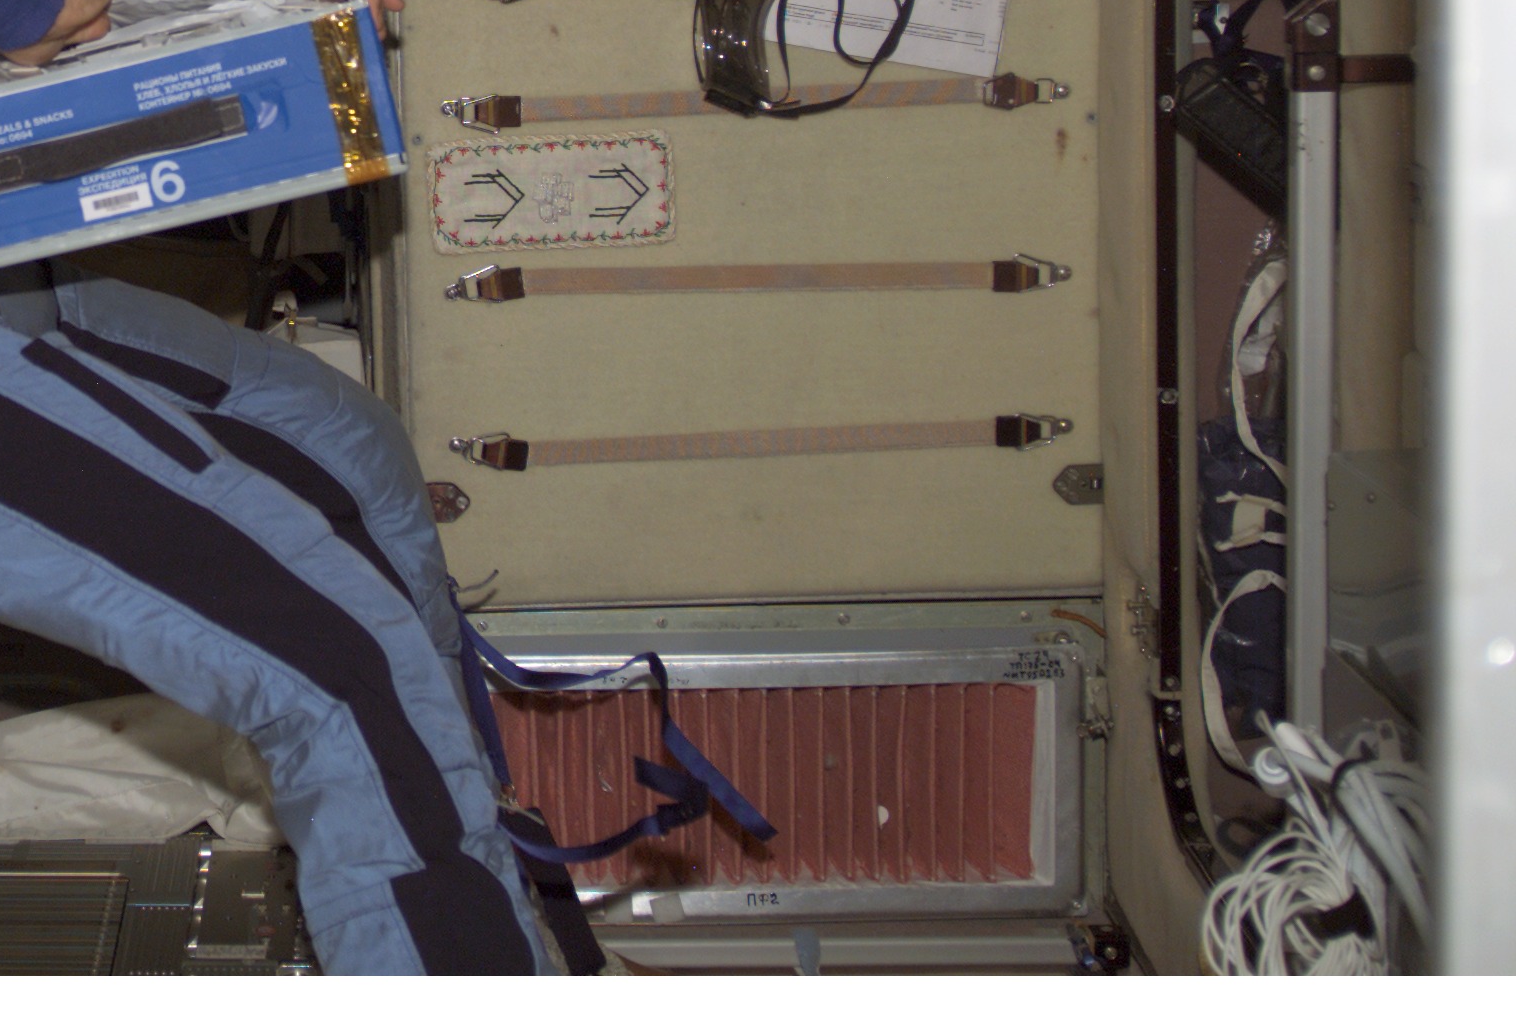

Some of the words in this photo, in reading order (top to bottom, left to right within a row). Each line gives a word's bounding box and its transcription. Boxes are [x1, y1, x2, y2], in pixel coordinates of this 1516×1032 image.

[133, 73, 179, 91] РАЦИОНЫ
[180, 62, 222, 79] ПИТАНИЯ
[165, 78, 201, 93] ХЛОПЬЯ
[246, 57, 287, 75] ЗАКУСКИ
[138, 91, 191, 111] КОНТЕЙНЕР
[25, 120, 31, 129] &
[33, 109, 74, 126] SNACKS
[78, 172, 147, 196] ЭКСПЕДИЦИЯ
[81, 164, 139, 185] EXPEDITION
[151, 160, 185, 202] 6
